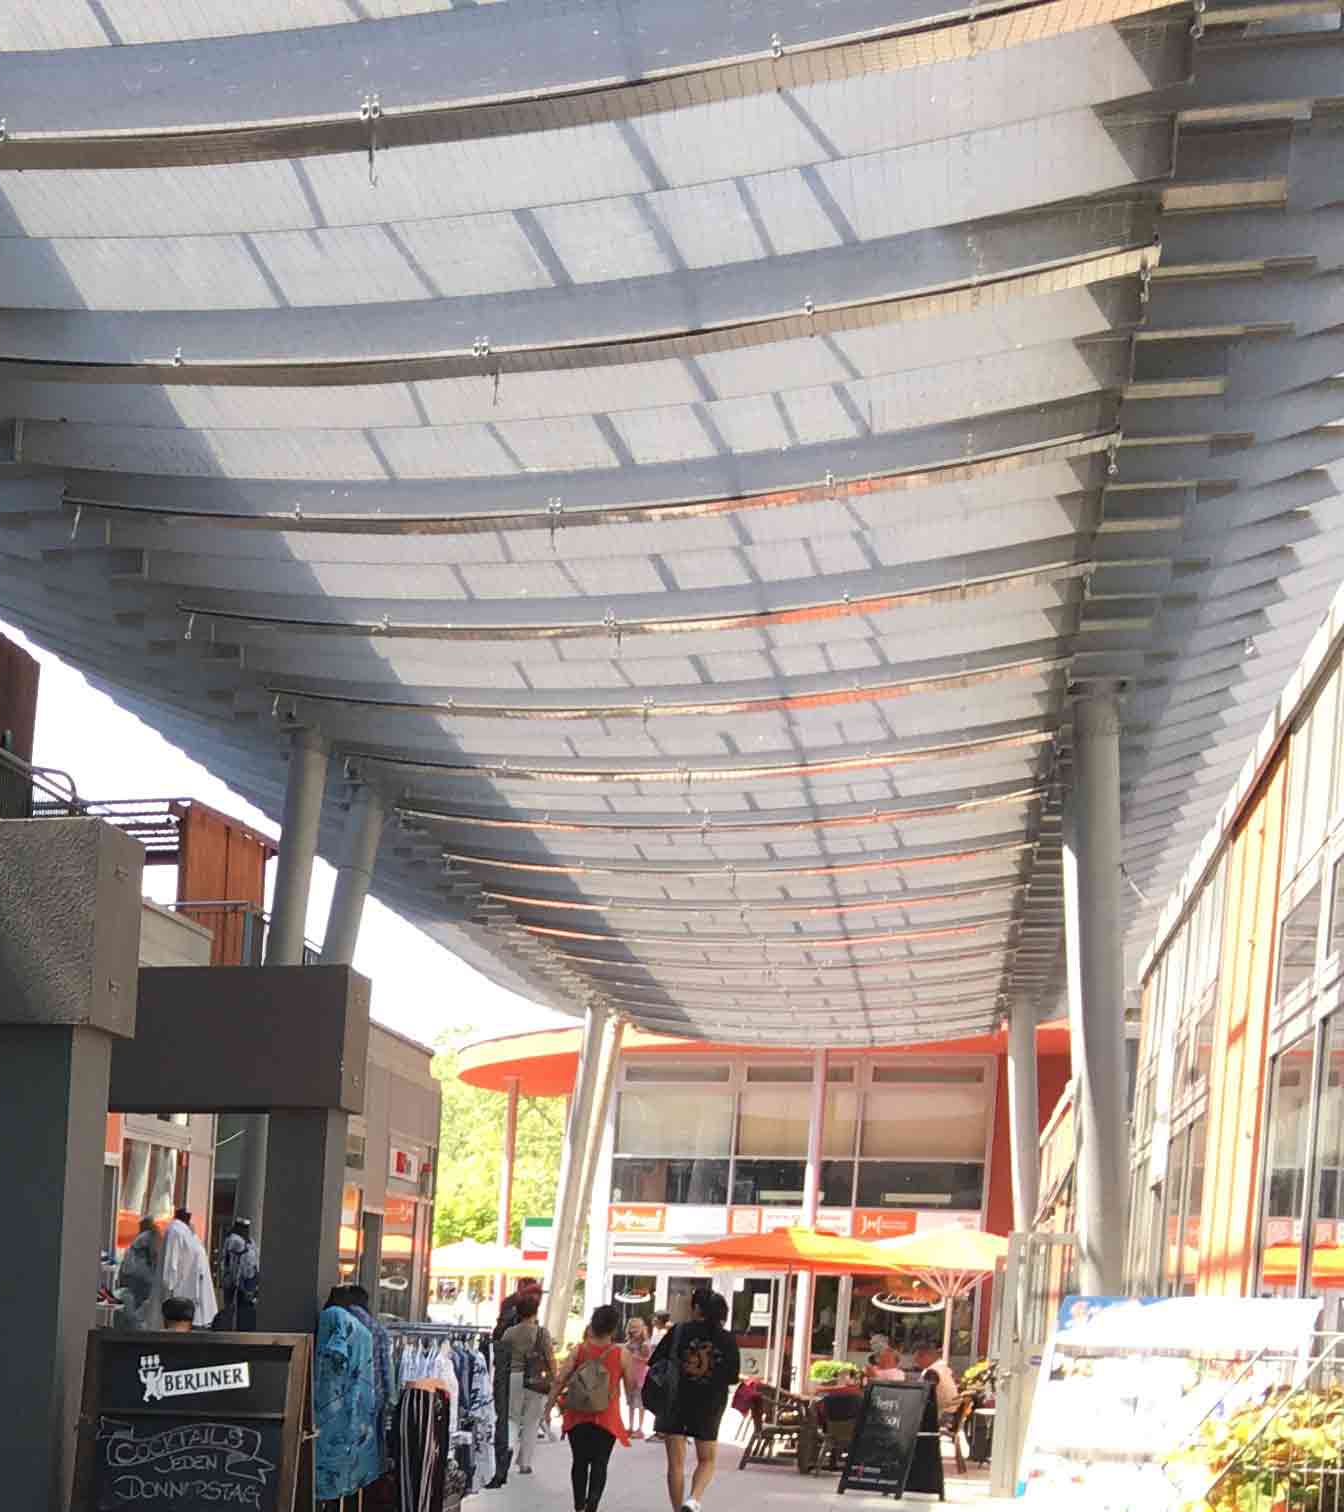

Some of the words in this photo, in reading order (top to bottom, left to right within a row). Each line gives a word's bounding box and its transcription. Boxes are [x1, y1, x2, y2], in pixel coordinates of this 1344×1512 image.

[164, 1367, 244, 1392] BERLINER
[115, 1425, 244, 1464] COCKTAILS
[154, 1455, 217, 1473] JEDEN
[113, 1475, 261, 1511] DONNRSTAG
